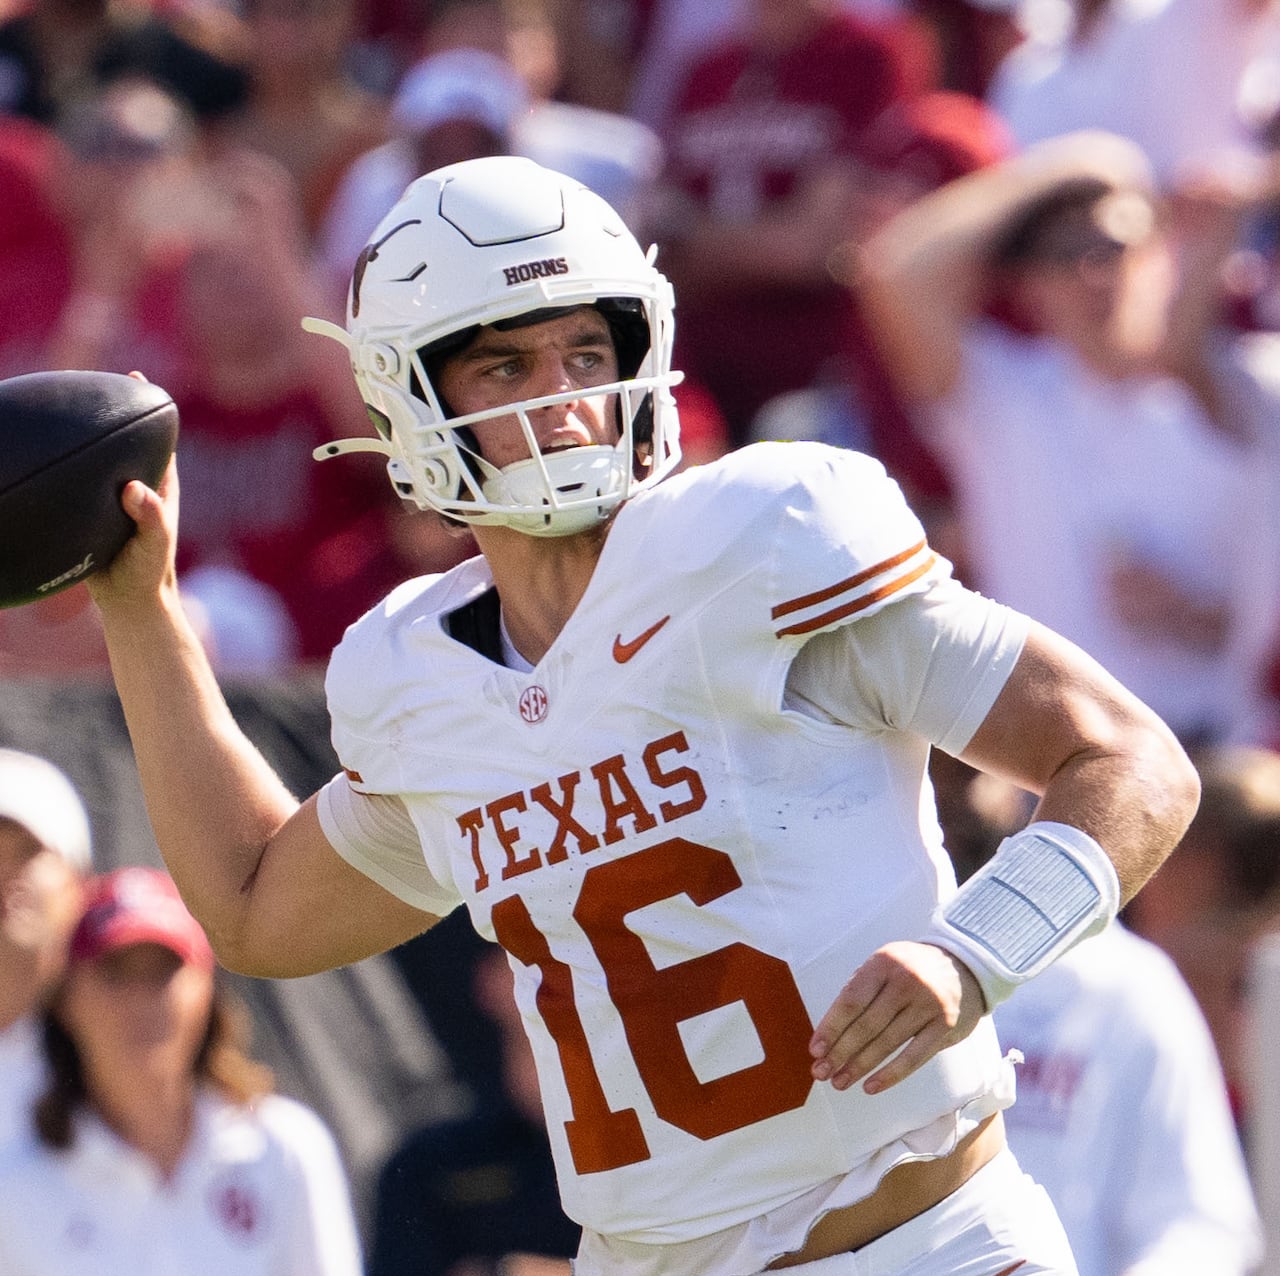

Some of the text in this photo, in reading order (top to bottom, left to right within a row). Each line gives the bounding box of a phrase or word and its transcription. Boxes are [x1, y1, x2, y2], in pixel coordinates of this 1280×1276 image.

[502, 256, 569, 286] HORNS
[519, 686, 548, 723] SEC
[455, 730, 708, 893] TEXAS
[490, 836, 816, 1176] 16
